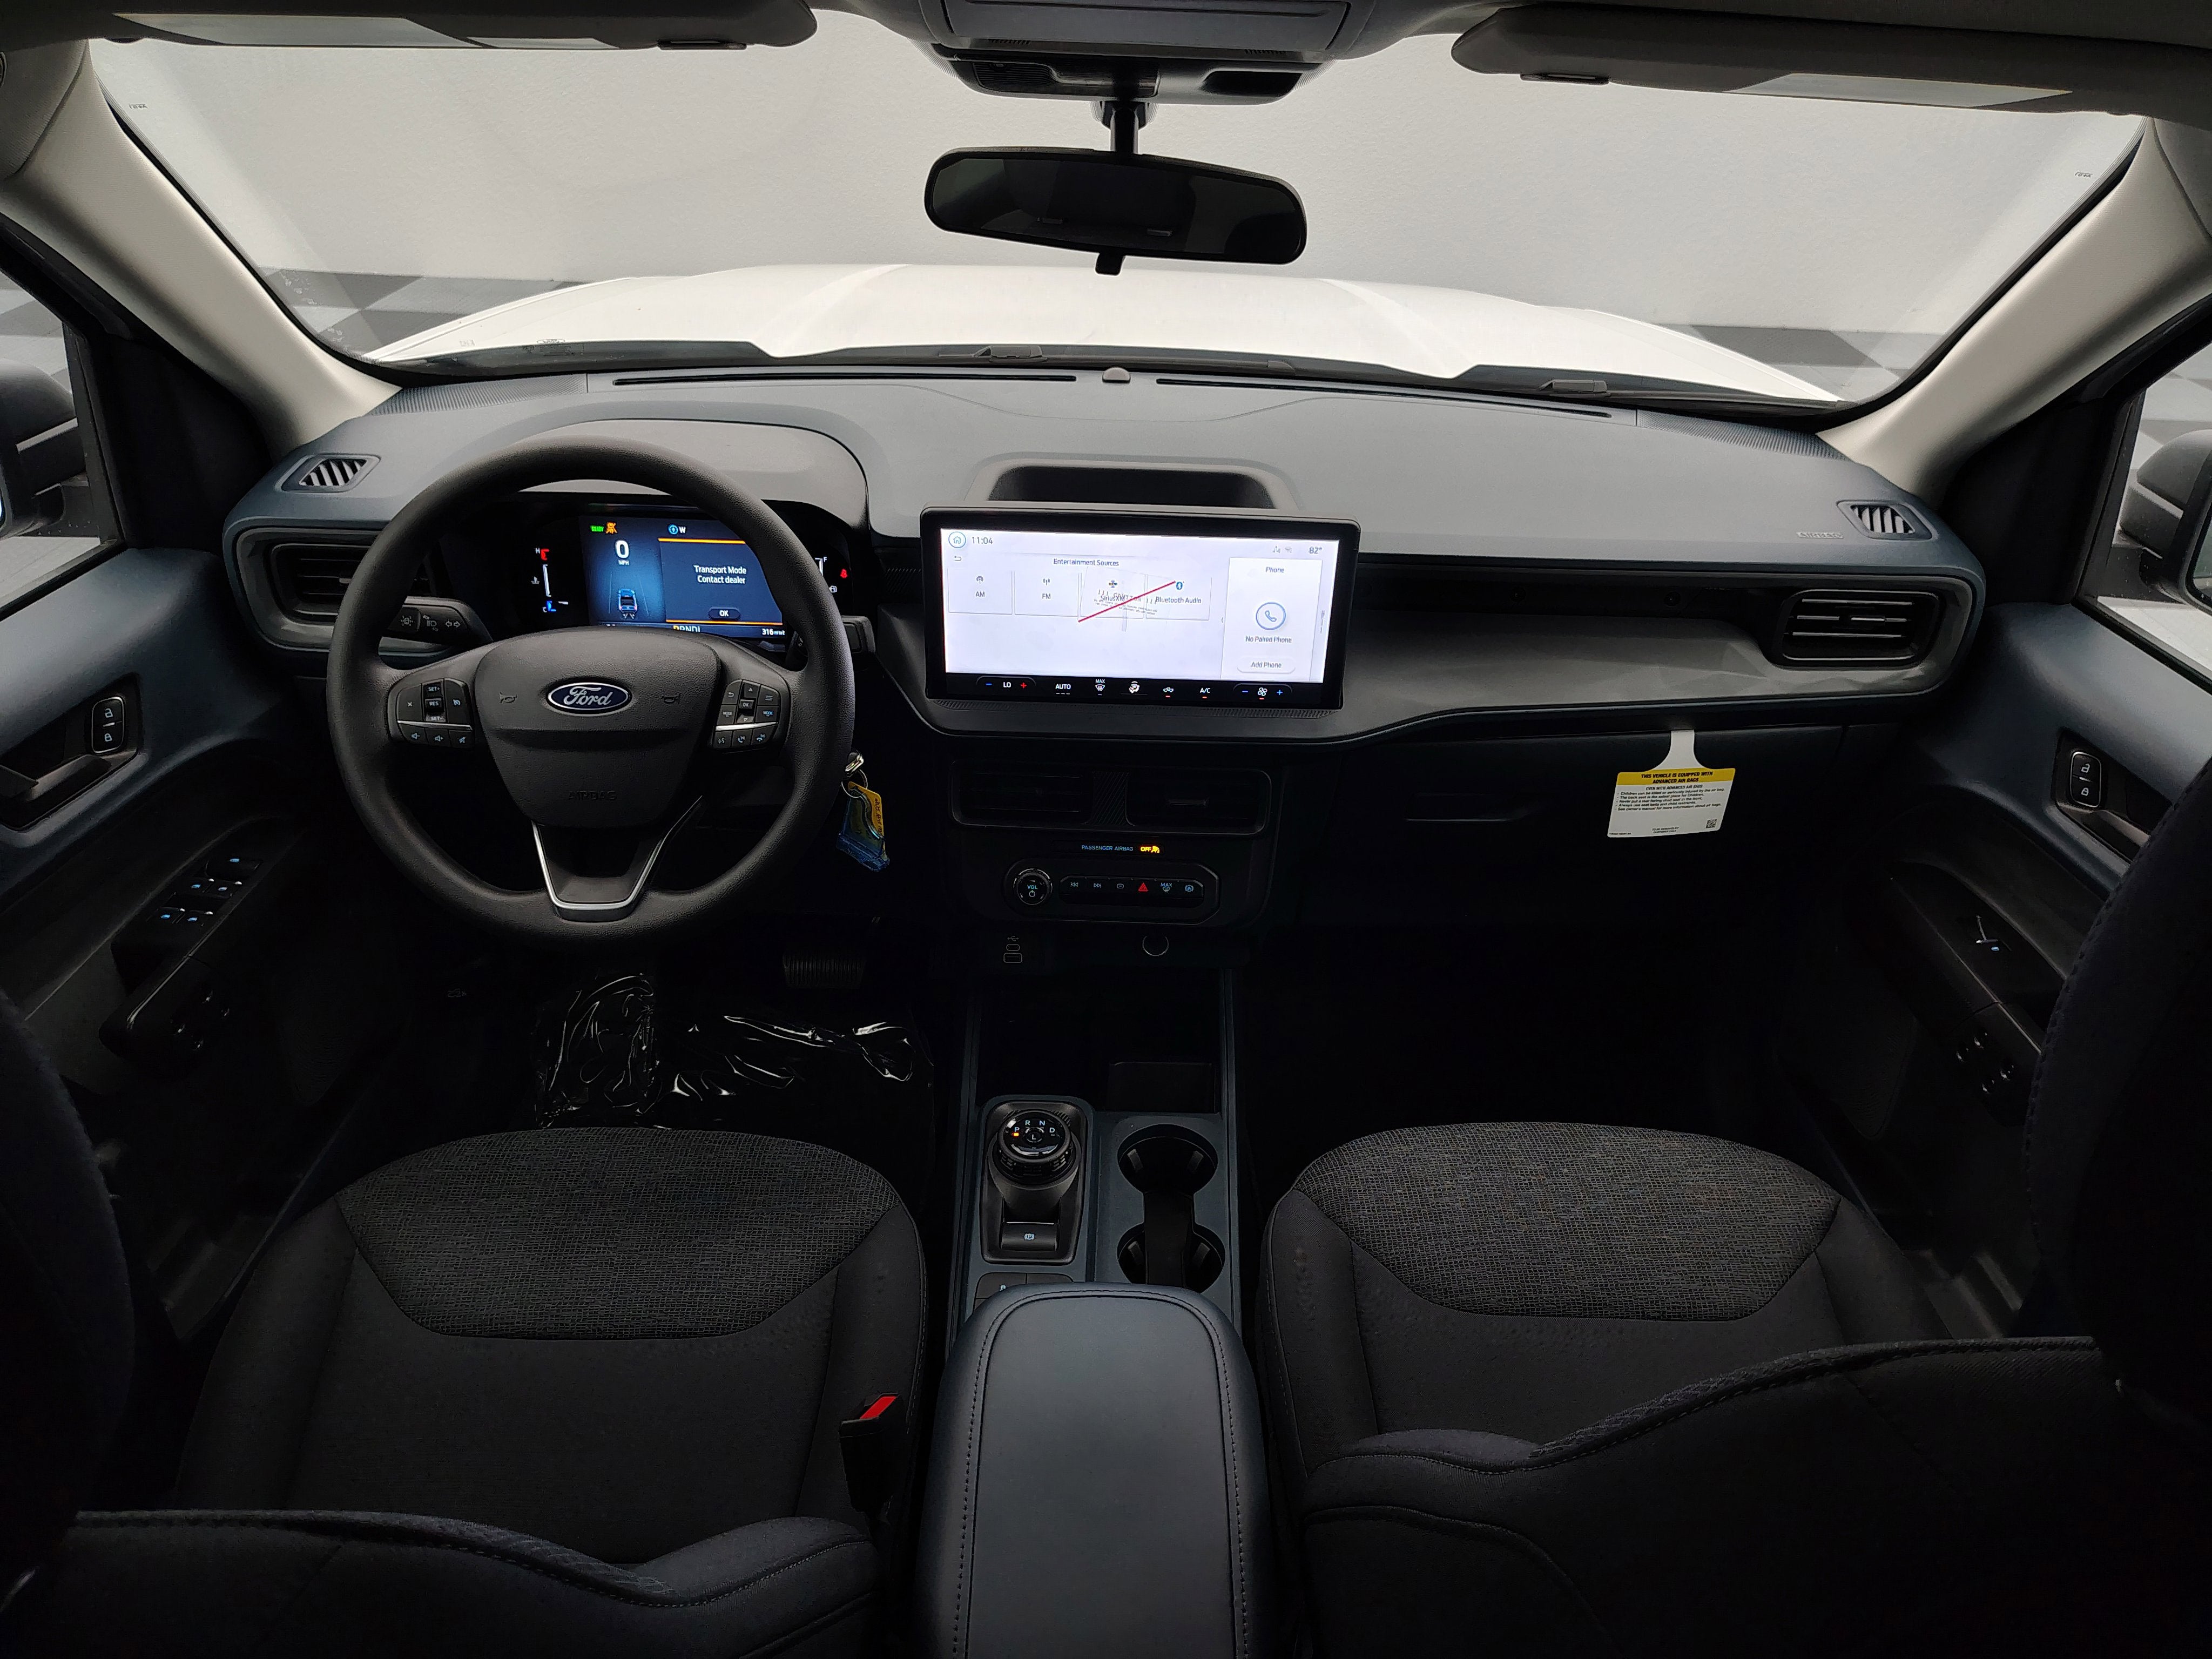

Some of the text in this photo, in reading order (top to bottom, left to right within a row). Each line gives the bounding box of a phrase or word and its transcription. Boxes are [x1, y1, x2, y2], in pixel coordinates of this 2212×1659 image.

[616, 540, 629, 558] 0
[693, 564, 747, 574] Transport Mode
[697, 575, 724, 583] Contact
[564, 686, 613, 705] Ford
